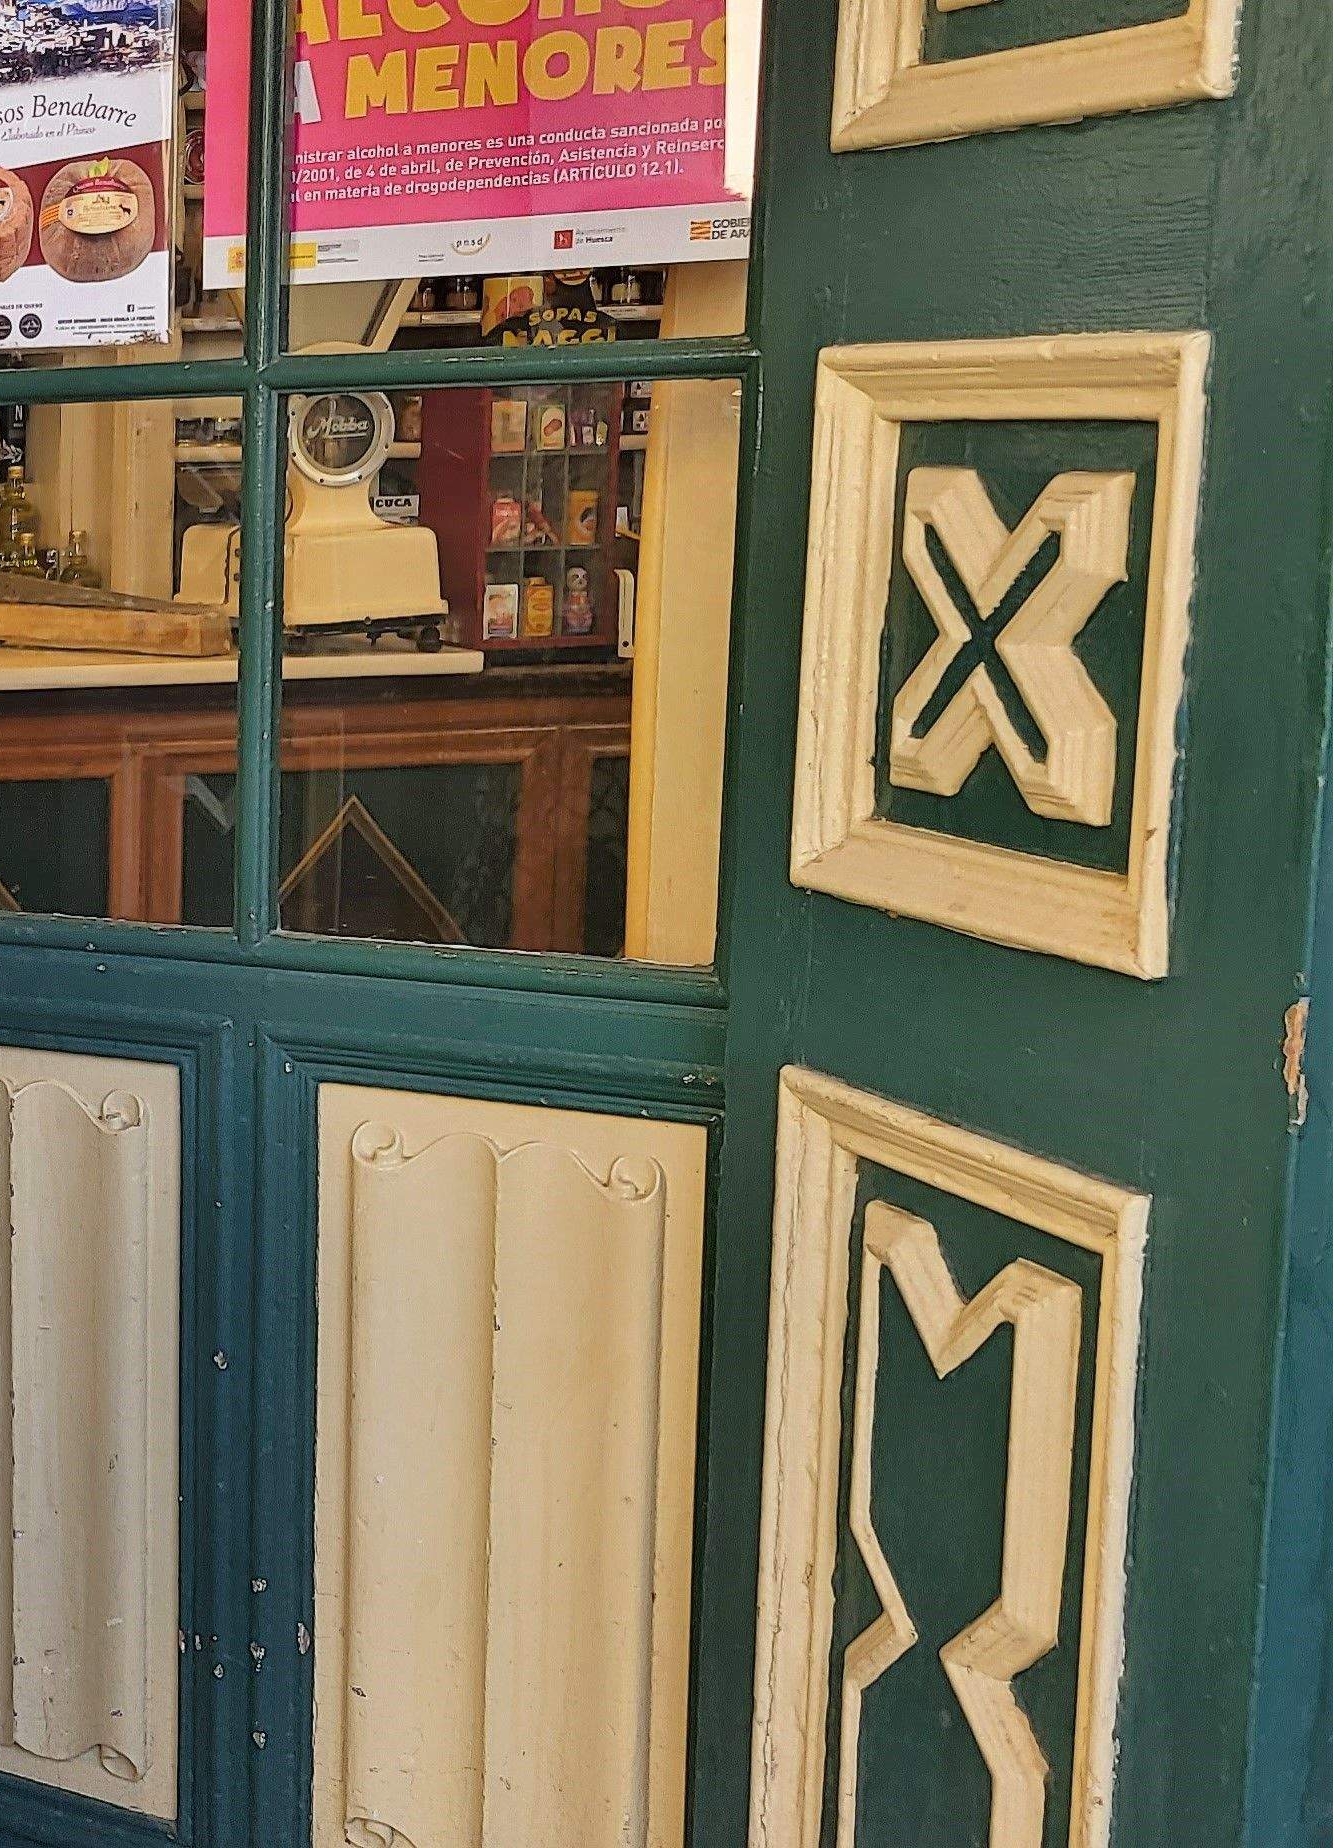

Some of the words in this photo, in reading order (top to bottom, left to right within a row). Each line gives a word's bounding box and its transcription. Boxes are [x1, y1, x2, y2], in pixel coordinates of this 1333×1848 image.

[32, 94, 137, 127] Benabarre
[346, 144, 398, 161] alcohol
[403, 145, 412, 156] a
[416, 139, 482, 155] menores
[486, 137, 504, 149] es
[507, 134, 534, 147] una
[539, 126, 606, 145] conducta
[610, 117, 699, 138] sancionada
[704, 118, 725, 134] po
[345, 166, 362, 180] de
[366, 165, 376, 178] 4
[379, 162, 397, 177] de
[401, 158, 441, 175] abril,
[445, 157, 464, 172] de
[468, 151, 555, 170] Prevención,
[558, 143, 637, 163] Asistencia
[641, 144, 652, 159] y
[303, 190, 322, 202] en
[325, 182, 381, 201] materia
[385, 179, 402, 196] de
[406, 171, 550, 196] drogodependencias
[553, 162, 636, 184] (ARTÍCULO
[642, 158, 684, 177] 12.1).
[712, 230, 727, 239] DE
[713, 217, 751, 228] GOBIE
[528, 308, 598, 327] SOPAS
[375, 498, 413, 508] CUCA
